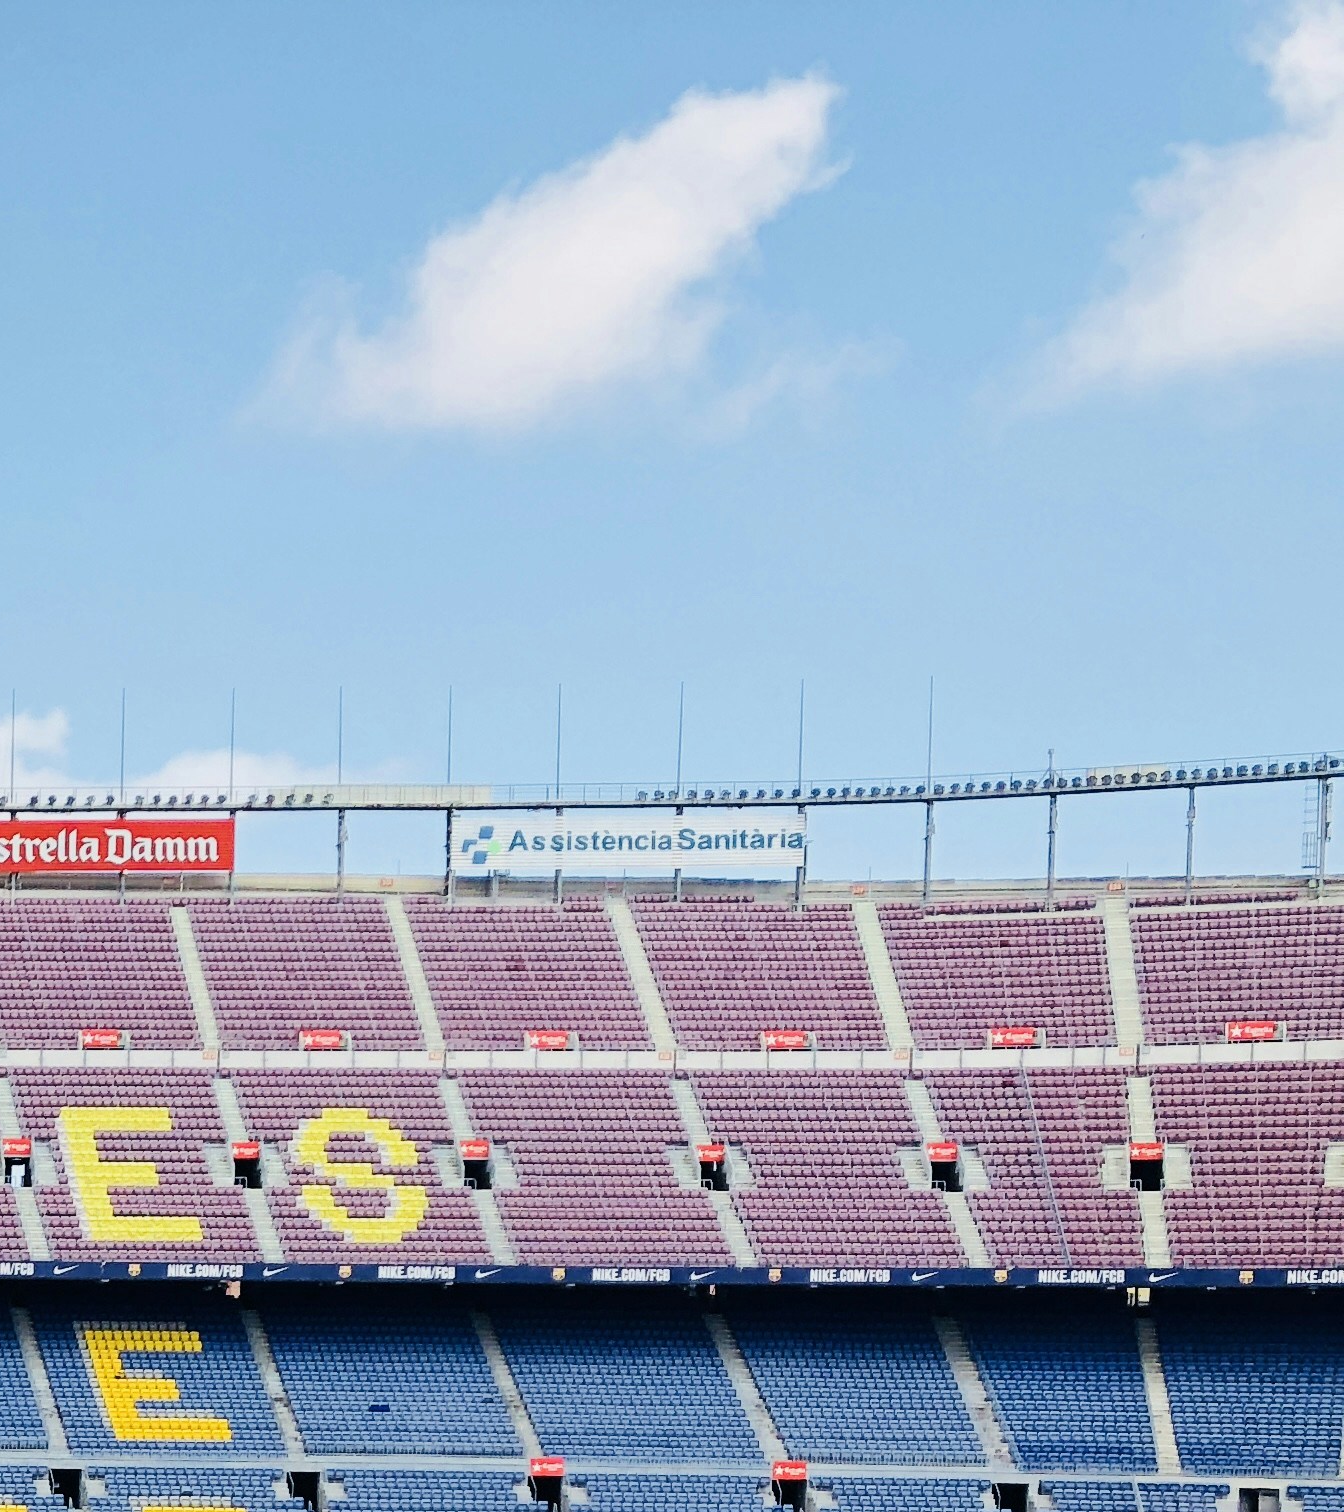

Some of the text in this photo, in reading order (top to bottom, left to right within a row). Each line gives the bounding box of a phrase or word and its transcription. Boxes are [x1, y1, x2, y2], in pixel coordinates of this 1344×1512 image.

[103, 827, 220, 865] Damm
[509, 827, 805, 852] Assistència Sanitària
[167, 1263, 244, 1278] NIKE.COM/FCB
[378, 1265, 456, 1279] NIKE.COM/FCB
[592, 1268, 671, 1283] NIKE.COM/FCB
[809, 1268, 891, 1283] NIKE.COM/FCB
[1038, 1269, 1126, 1284] NIKE.COM/FCB
